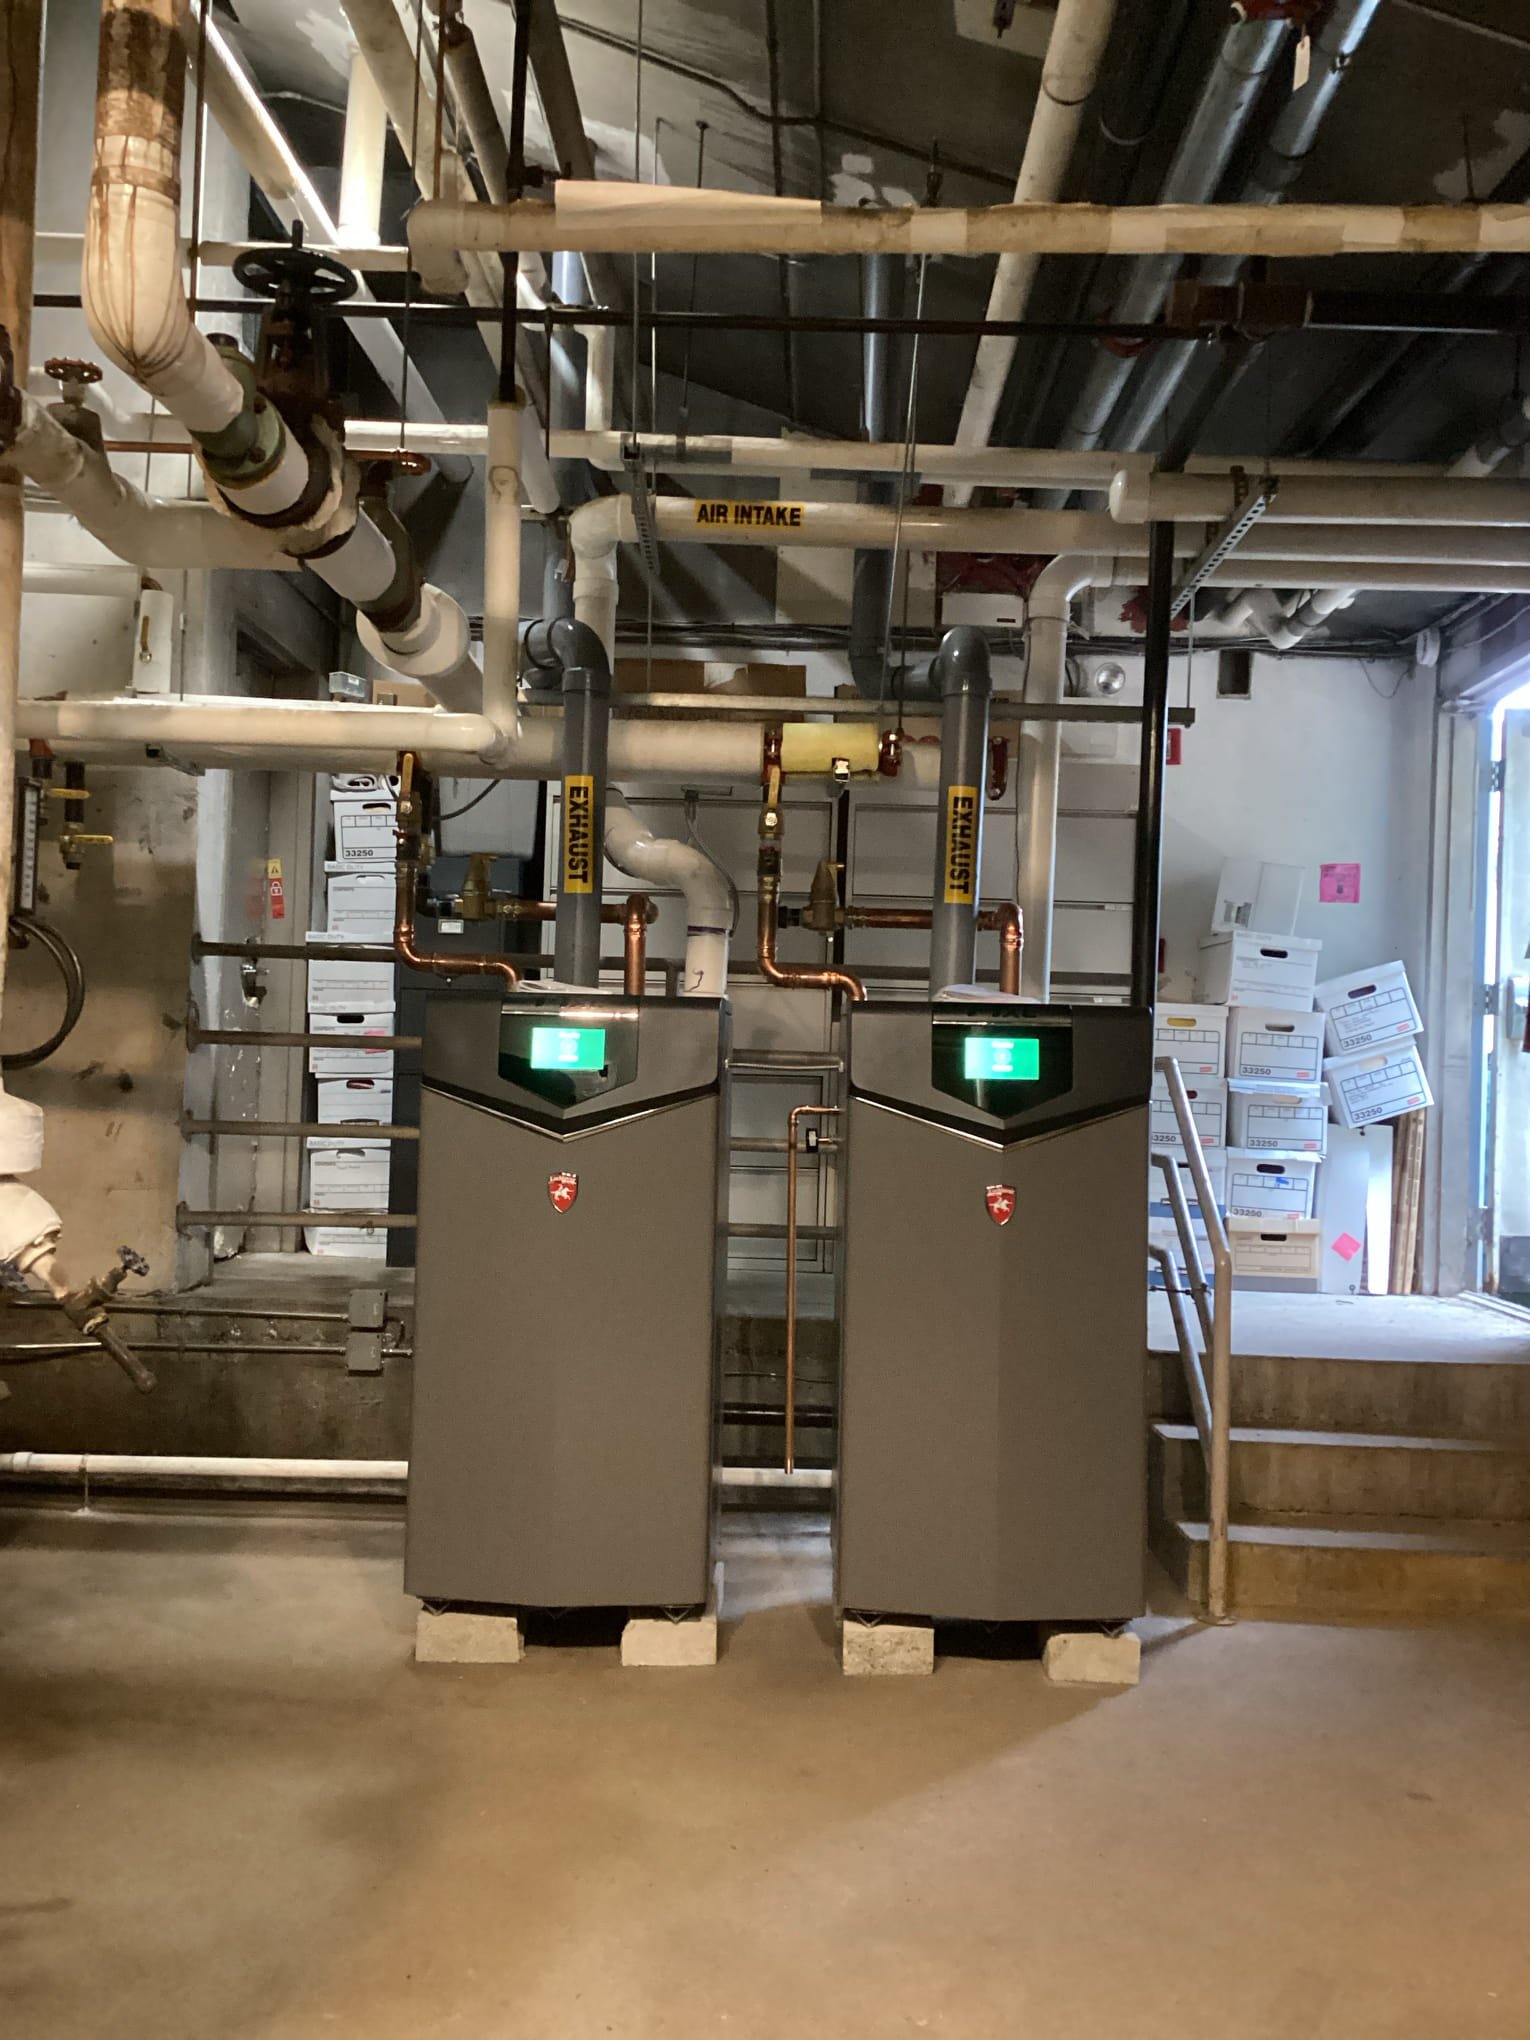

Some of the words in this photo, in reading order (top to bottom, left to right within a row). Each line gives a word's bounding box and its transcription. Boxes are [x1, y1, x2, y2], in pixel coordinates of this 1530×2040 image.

[697, 504, 728, 523] AIR
[734, 505, 801, 526] INTAKE
[568, 786, 589, 884] EXHAUST
[949, 796, 974, 894] EXHAUST
[345, 849, 374, 857] 33250
[1343, 1034, 1373, 1048] 33250
[1242, 1066, 1272, 1076] 33250
[1354, 1106, 1383, 1121] 33250
[1249, 1139, 1278, 1148] 33250
[1233, 1208, 1263, 1218] 33250
